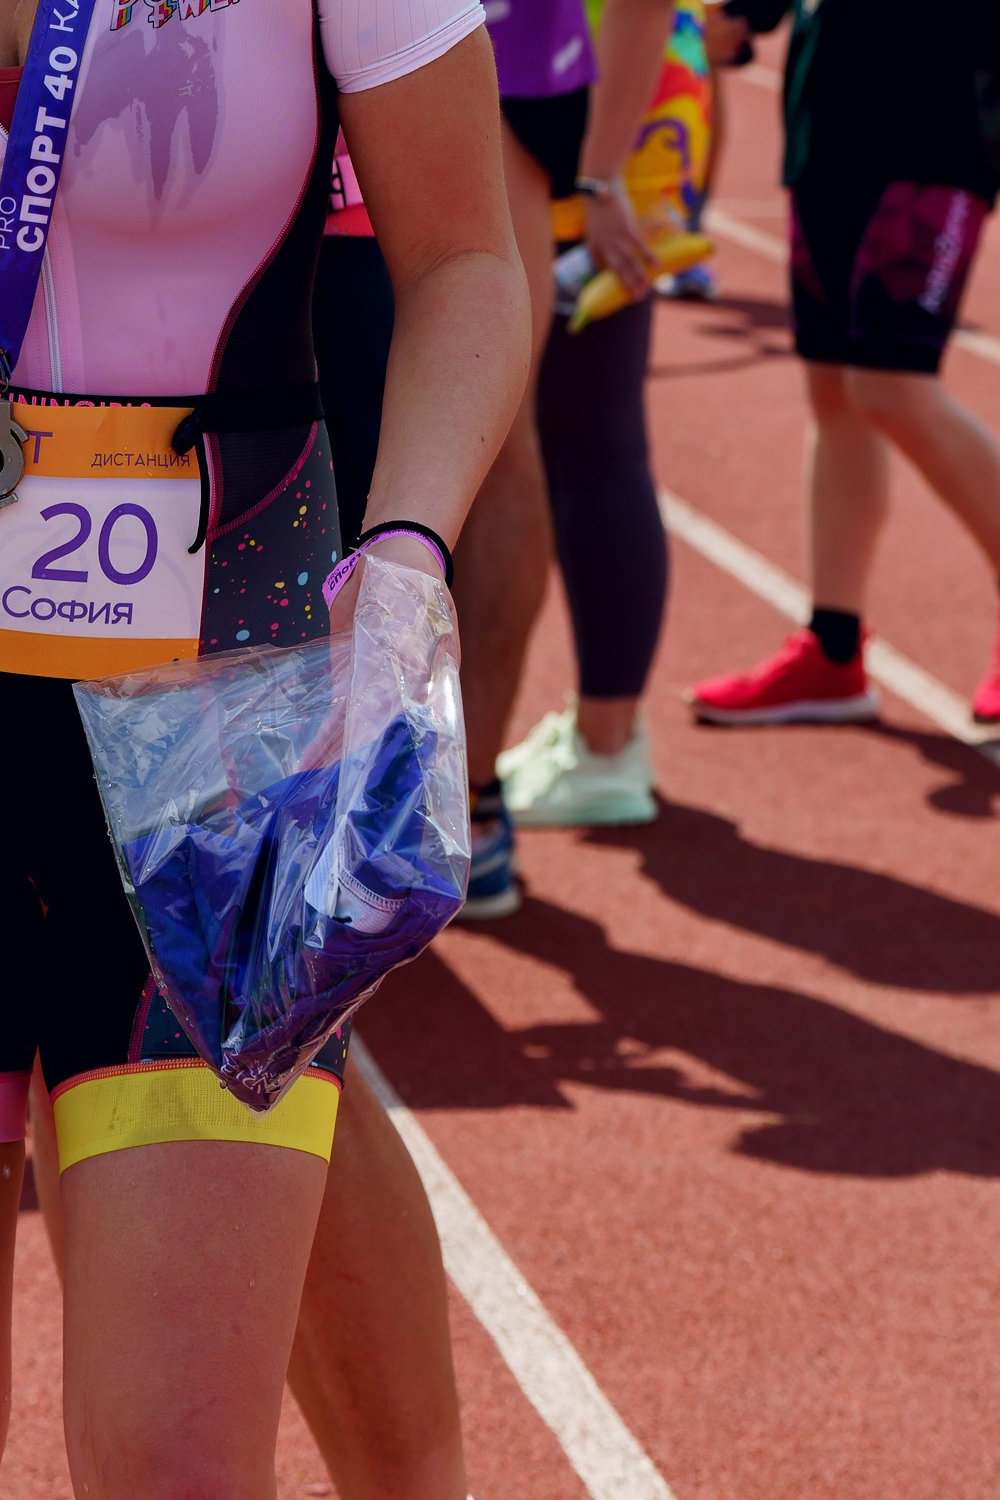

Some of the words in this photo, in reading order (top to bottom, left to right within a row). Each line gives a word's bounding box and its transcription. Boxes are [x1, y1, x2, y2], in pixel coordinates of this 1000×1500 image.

[16, 106, 67, 252] СПОРТ
[43, 46, 78, 101] 40
[90, 452, 191, 469] ДИСТАНЦИЯ
[31, 502, 158, 586] 20
